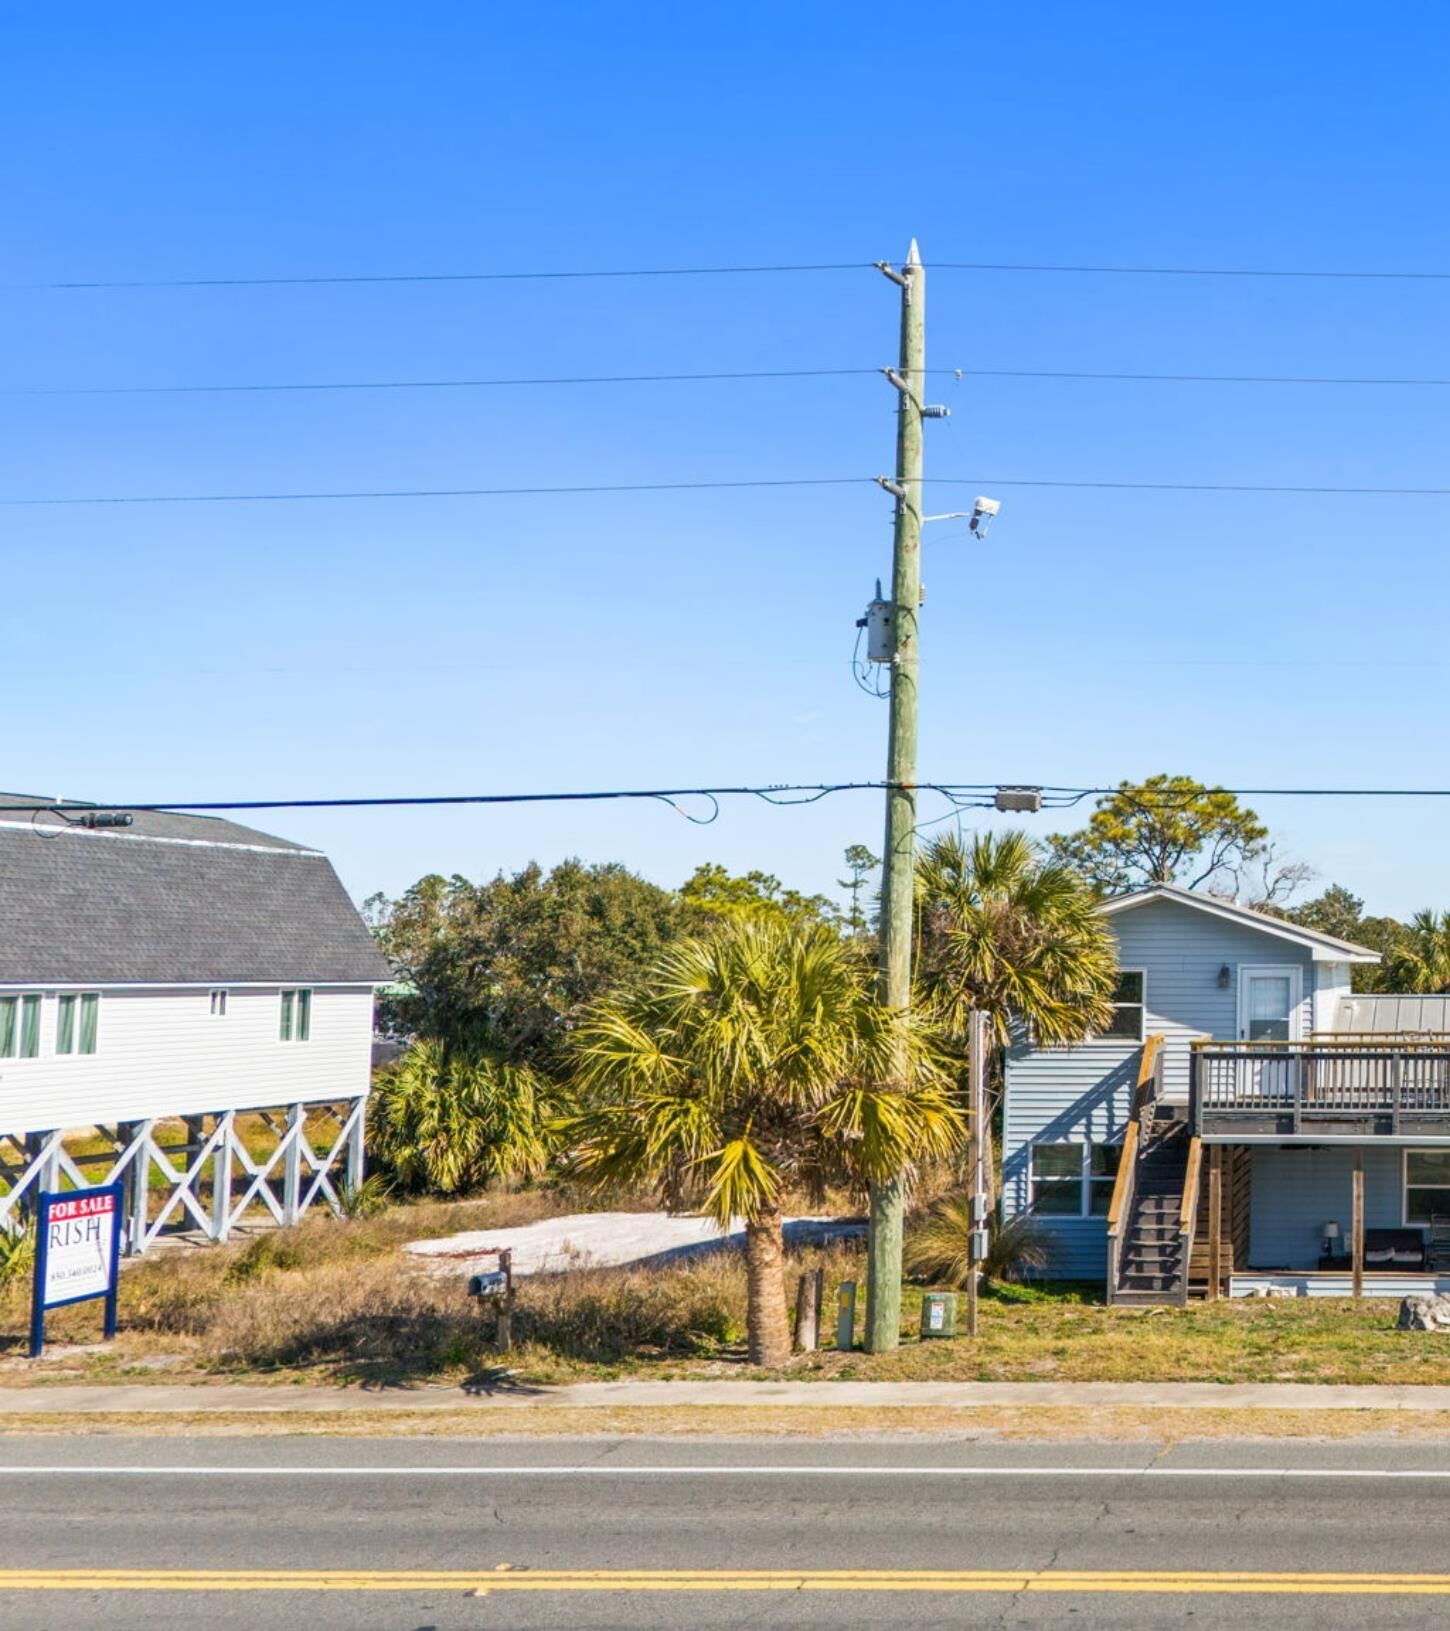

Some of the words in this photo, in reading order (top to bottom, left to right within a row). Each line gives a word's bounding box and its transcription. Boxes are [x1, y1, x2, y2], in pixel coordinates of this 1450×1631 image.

[49, 1202, 77, 1220] FOR
[80, 1195, 113, 1214] SALE
[50, 1216, 101, 1248] RISH
